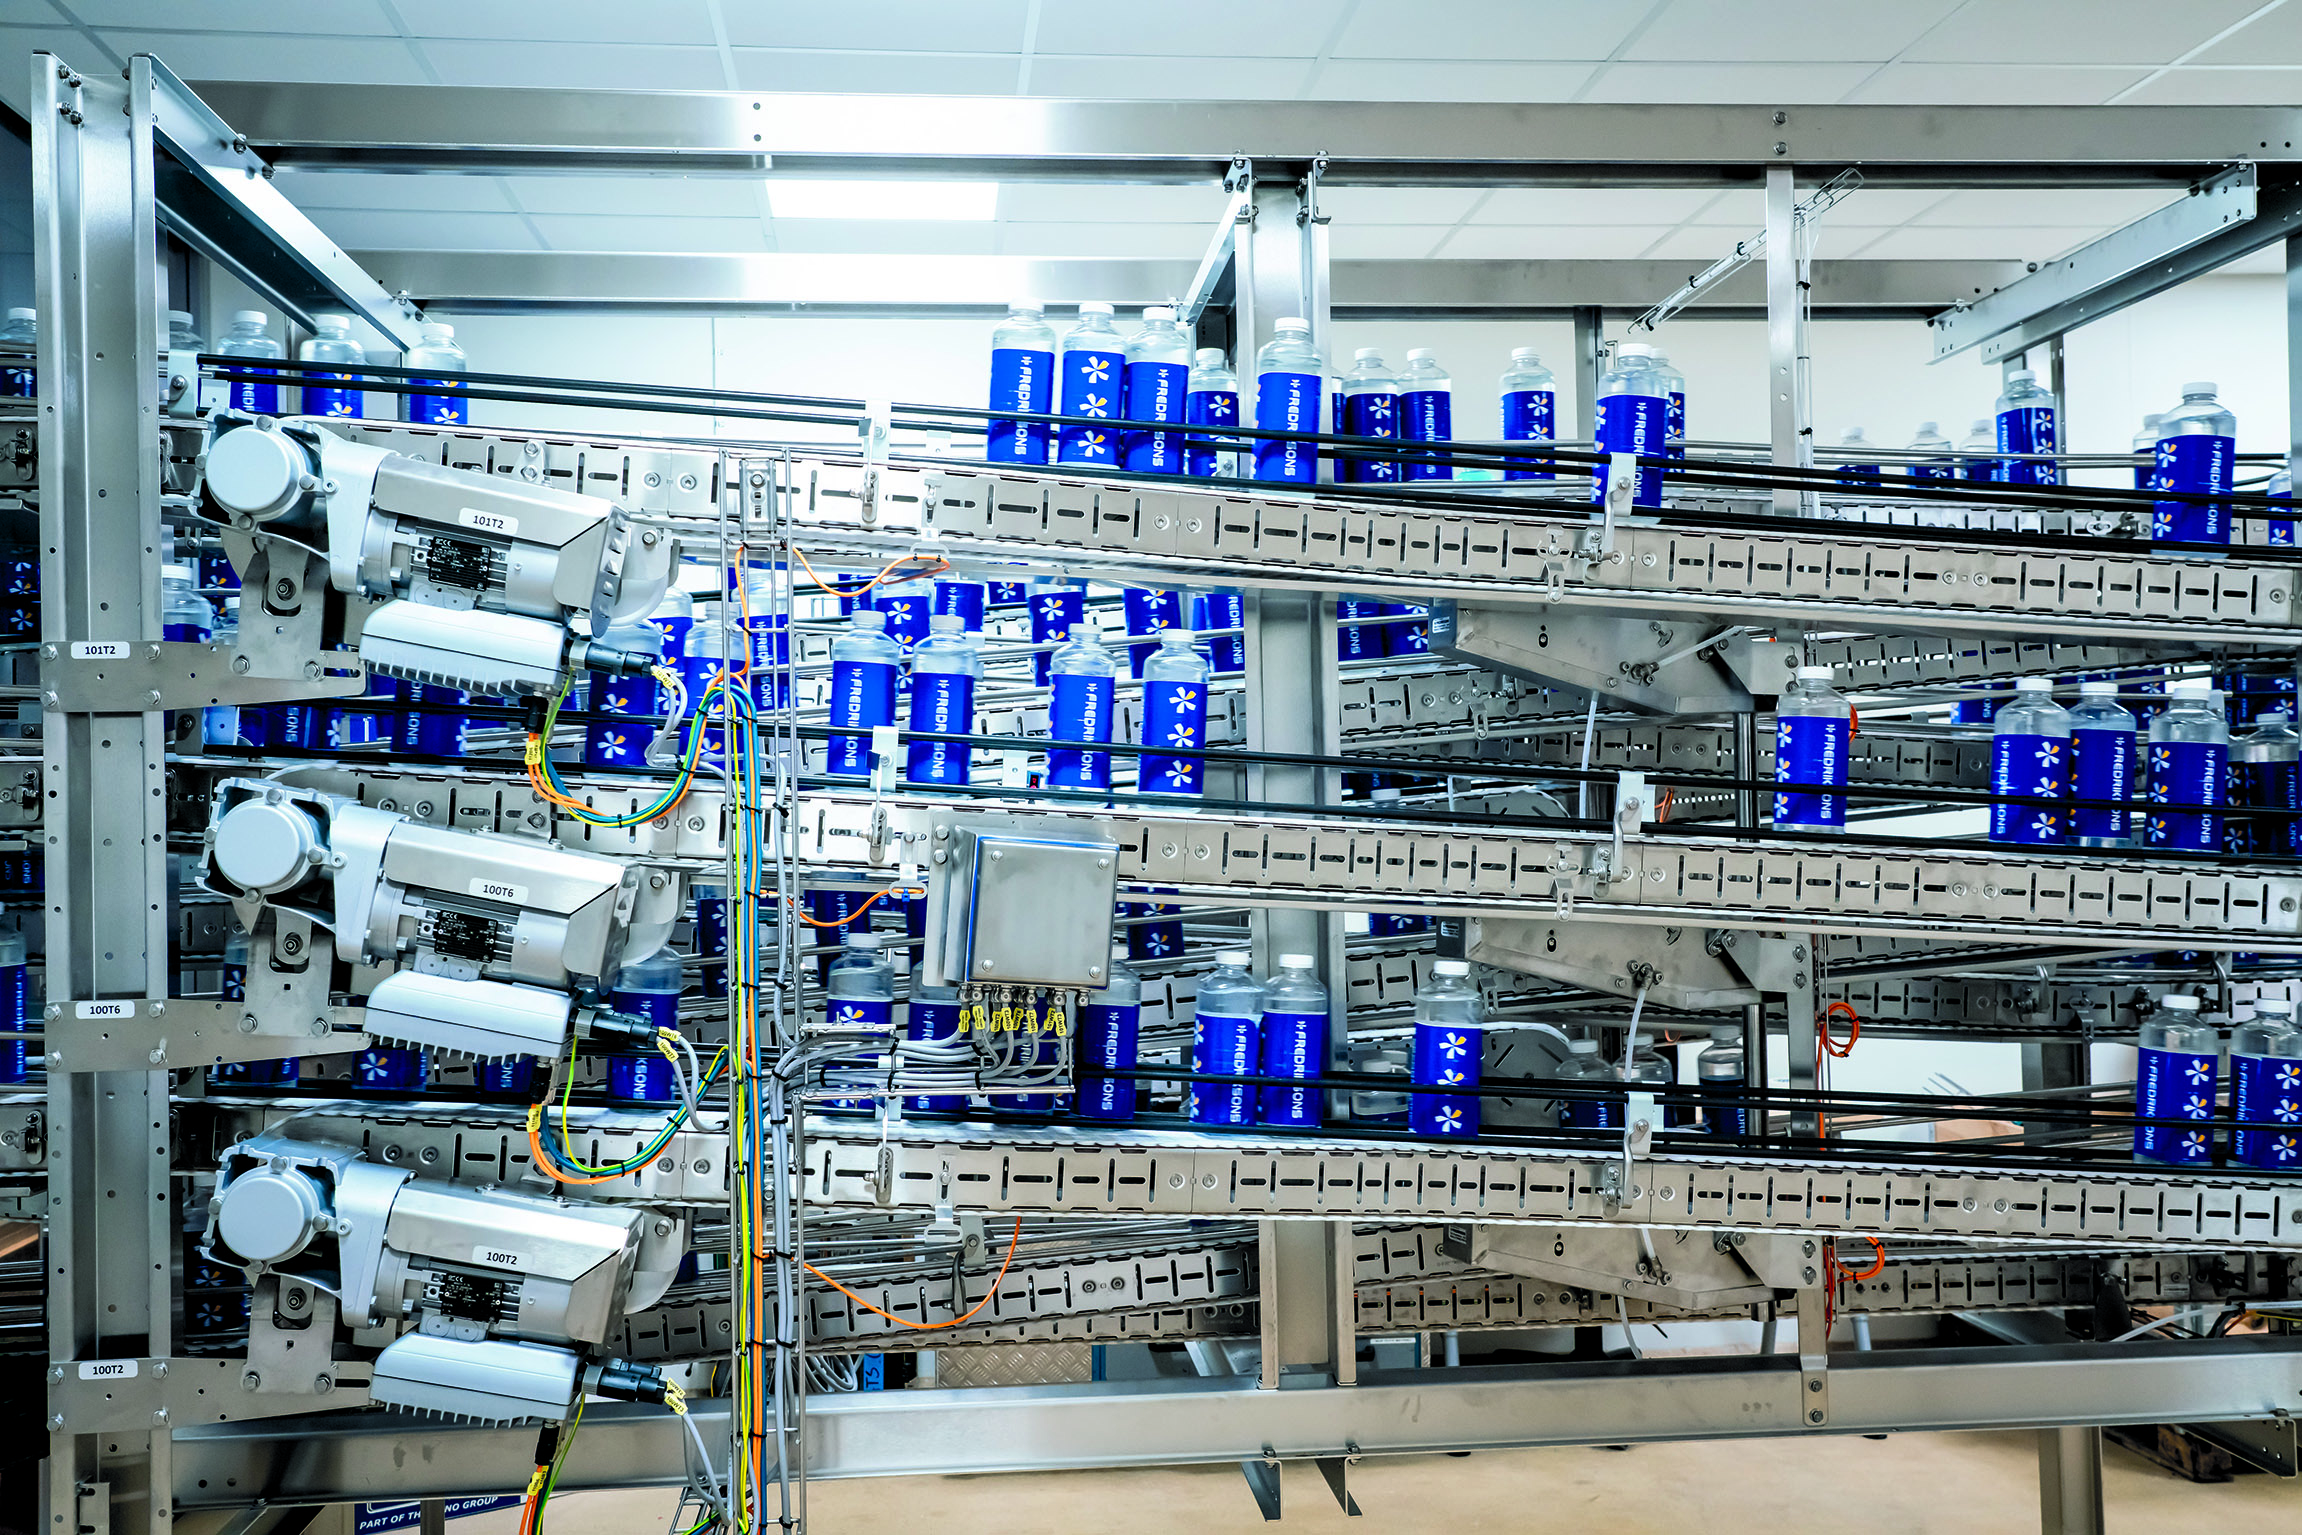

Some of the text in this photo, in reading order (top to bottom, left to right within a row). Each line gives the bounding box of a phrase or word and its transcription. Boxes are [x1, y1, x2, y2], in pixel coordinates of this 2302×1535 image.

[1013, 366, 1032, 455] FREDRISONS
[1151, 379, 1168, 467] FREDRSONS
[1283, 389, 1300, 477] FREDRSONS
[1632, 412, 1647, 498] FREDRIONS
[2206, 460, 2222, 535] FREDRIONS
[473, 515, 504, 530] 101T2
[84, 645, 116, 655] 101T2
[844, 678, 863, 768] FREDRIONS
[931, 689, 950, 779] FREDRSONS
[1079, 693, 1098, 781] FREDRIONS
[1820, 724, 1836, 820] FREDRIKONS
[1996, 750, 2010, 835] FREDRISONS
[2110, 747, 2125, 831] FREDRIKONS
[2200, 759, 2215, 844] FREDRIONS
[482, 884, 515, 898] 100T6
[90, 1005, 121, 1015] 100T6
[1102, 1022, 1119, 1111] FREDRISONS
[1229, 1035, 1247, 1123] FREDRSONS
[1291, 1030, 1307, 1119] FREDRIONS
[2144, 1065, 2158, 1151] FREDRIKONS
[2235, 1072, 2248, 1156] FREDRIKONS
[486, 1251, 518, 1265] 100T2
[92, 1364, 124, 1375] 100T2
[359, 1496, 498, 1530] PART OF TH NO GROUP
